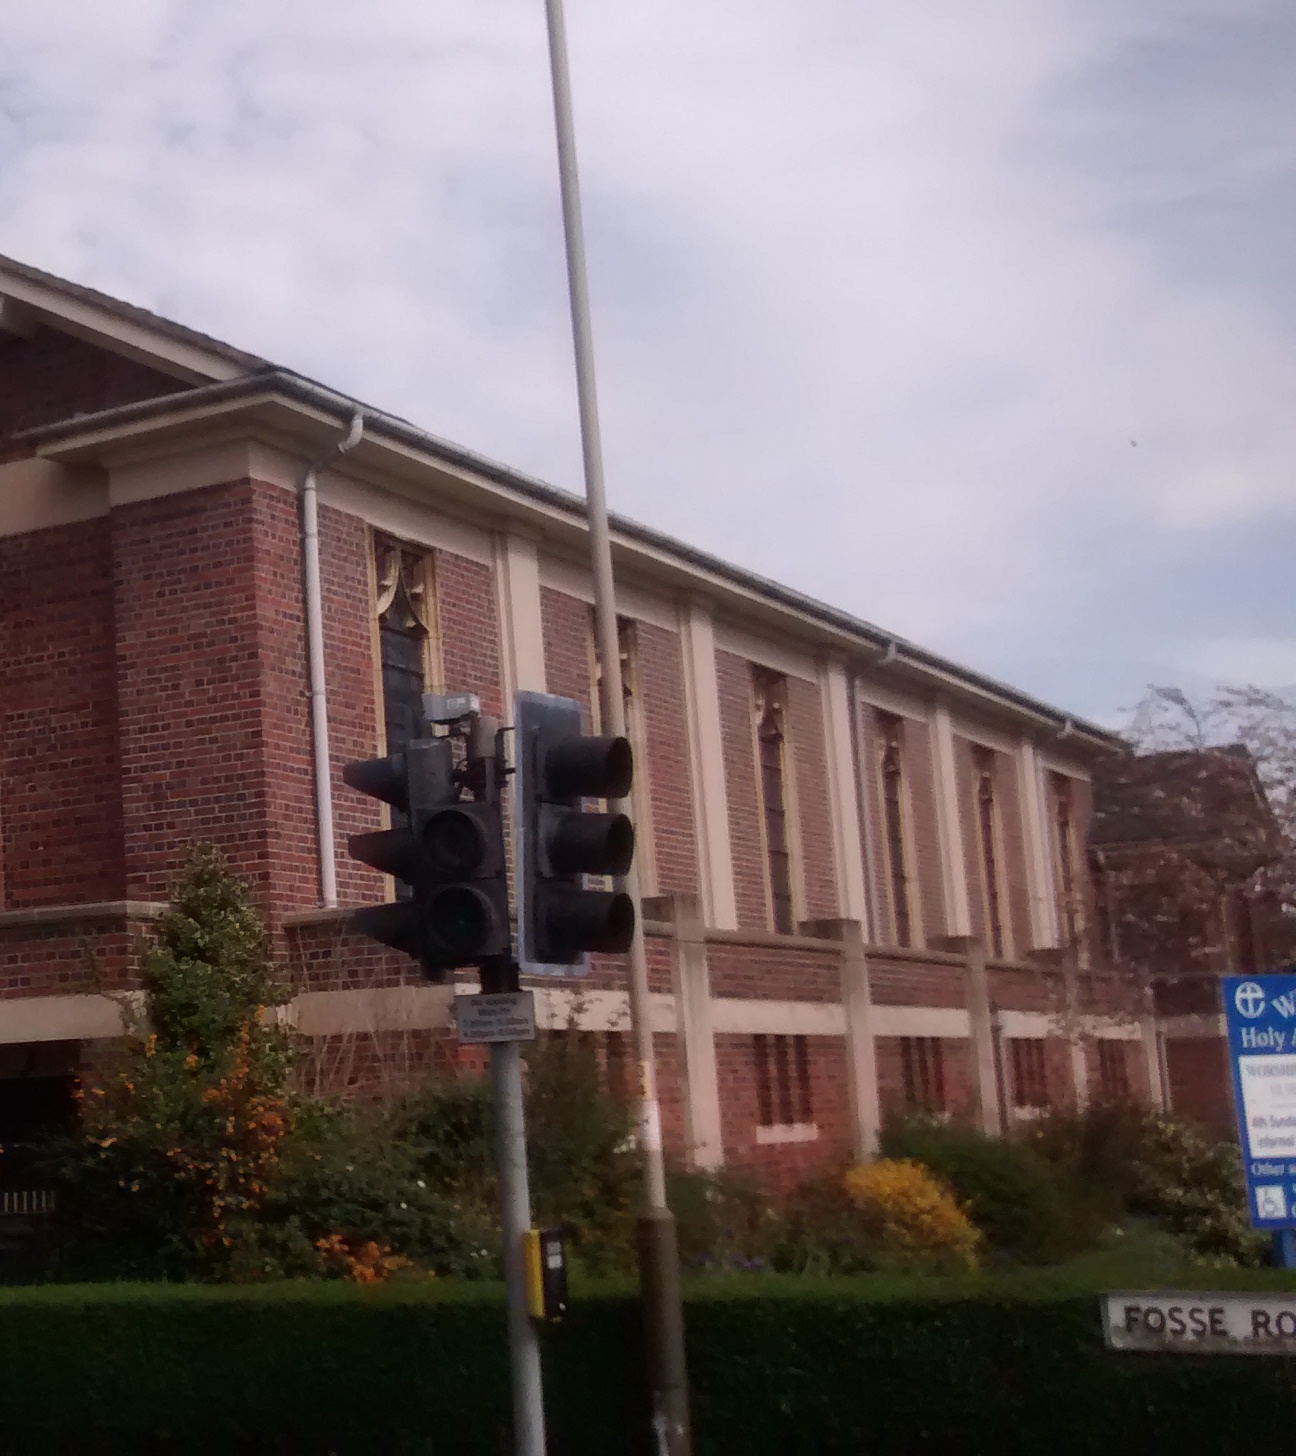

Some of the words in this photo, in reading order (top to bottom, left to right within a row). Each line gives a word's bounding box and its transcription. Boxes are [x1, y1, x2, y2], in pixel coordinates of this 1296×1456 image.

[1241, 1025, 1285, 1052] Holy
[1124, 1305, 1228, 1337] FOSSE
[1251, 1310, 1296, 1338] RO
